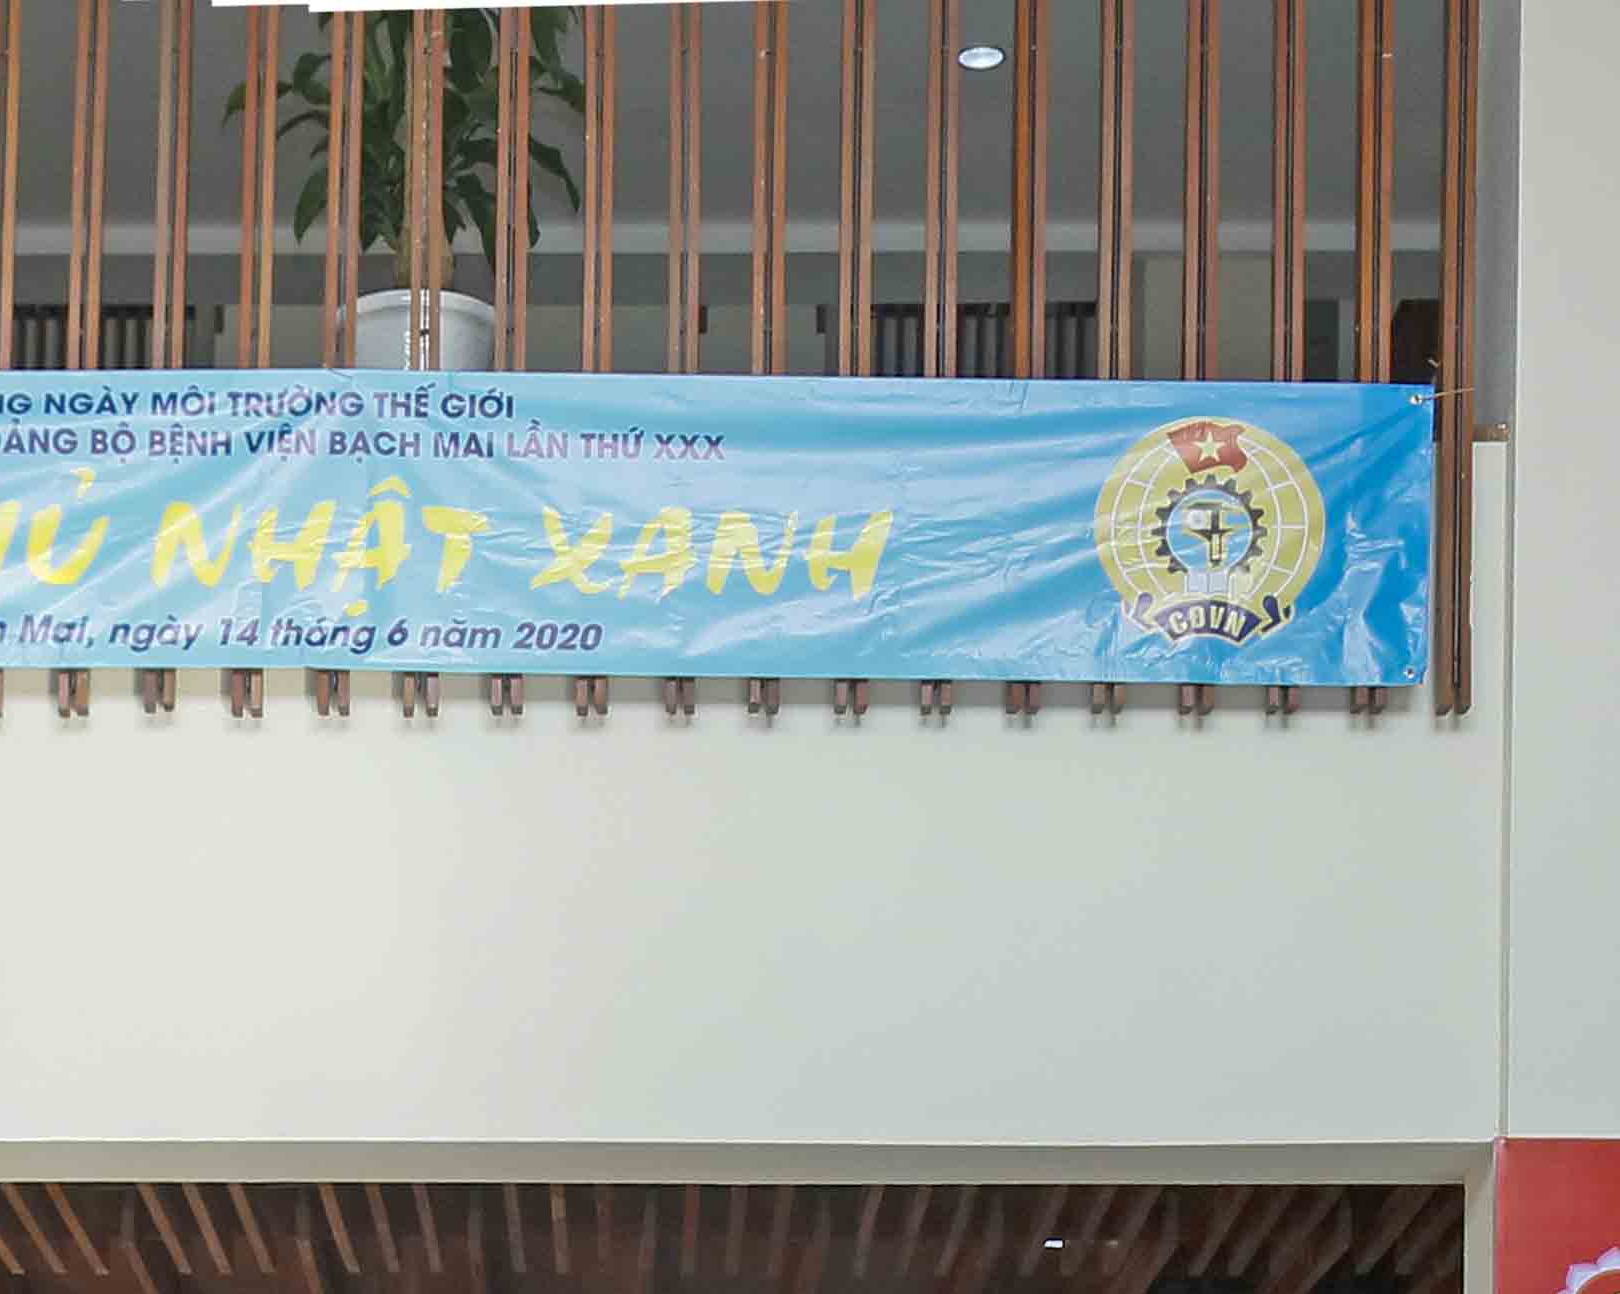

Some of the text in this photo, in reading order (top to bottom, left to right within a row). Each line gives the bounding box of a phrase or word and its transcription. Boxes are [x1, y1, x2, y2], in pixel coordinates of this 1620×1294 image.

[43, 386, 139, 415] NGÀY
[151, 385, 215, 418] MÔI
[228, 384, 365, 417] TRƯỜNG
[373, 382, 435, 418] THẾ
[439, 389, 515, 418] GIỚI
[89, 423, 137, 464] BỘ
[147, 424, 232, 465] BỆNH
[244, 424, 316, 463] VIỆN
[328, 431, 419, 464] BẠCH
[432, 431, 494, 458] MAI
[506, 420, 568, 459] LẦN
[580, 426, 645, 460] THỨ
[656, 433, 725, 461] XXX
[150, 475, 493, 619] NHẬT
[530, 502, 895, 602] XANH
[18, 616, 96, 651] Mai,
[107, 619, 200, 655] ngày
[219, 619, 260, 647] 14
[270, 617, 376, 656] tháng
[387, 621, 409, 648] 6
[418, 621, 502, 650] năm
[513, 623, 603, 652] 2020
